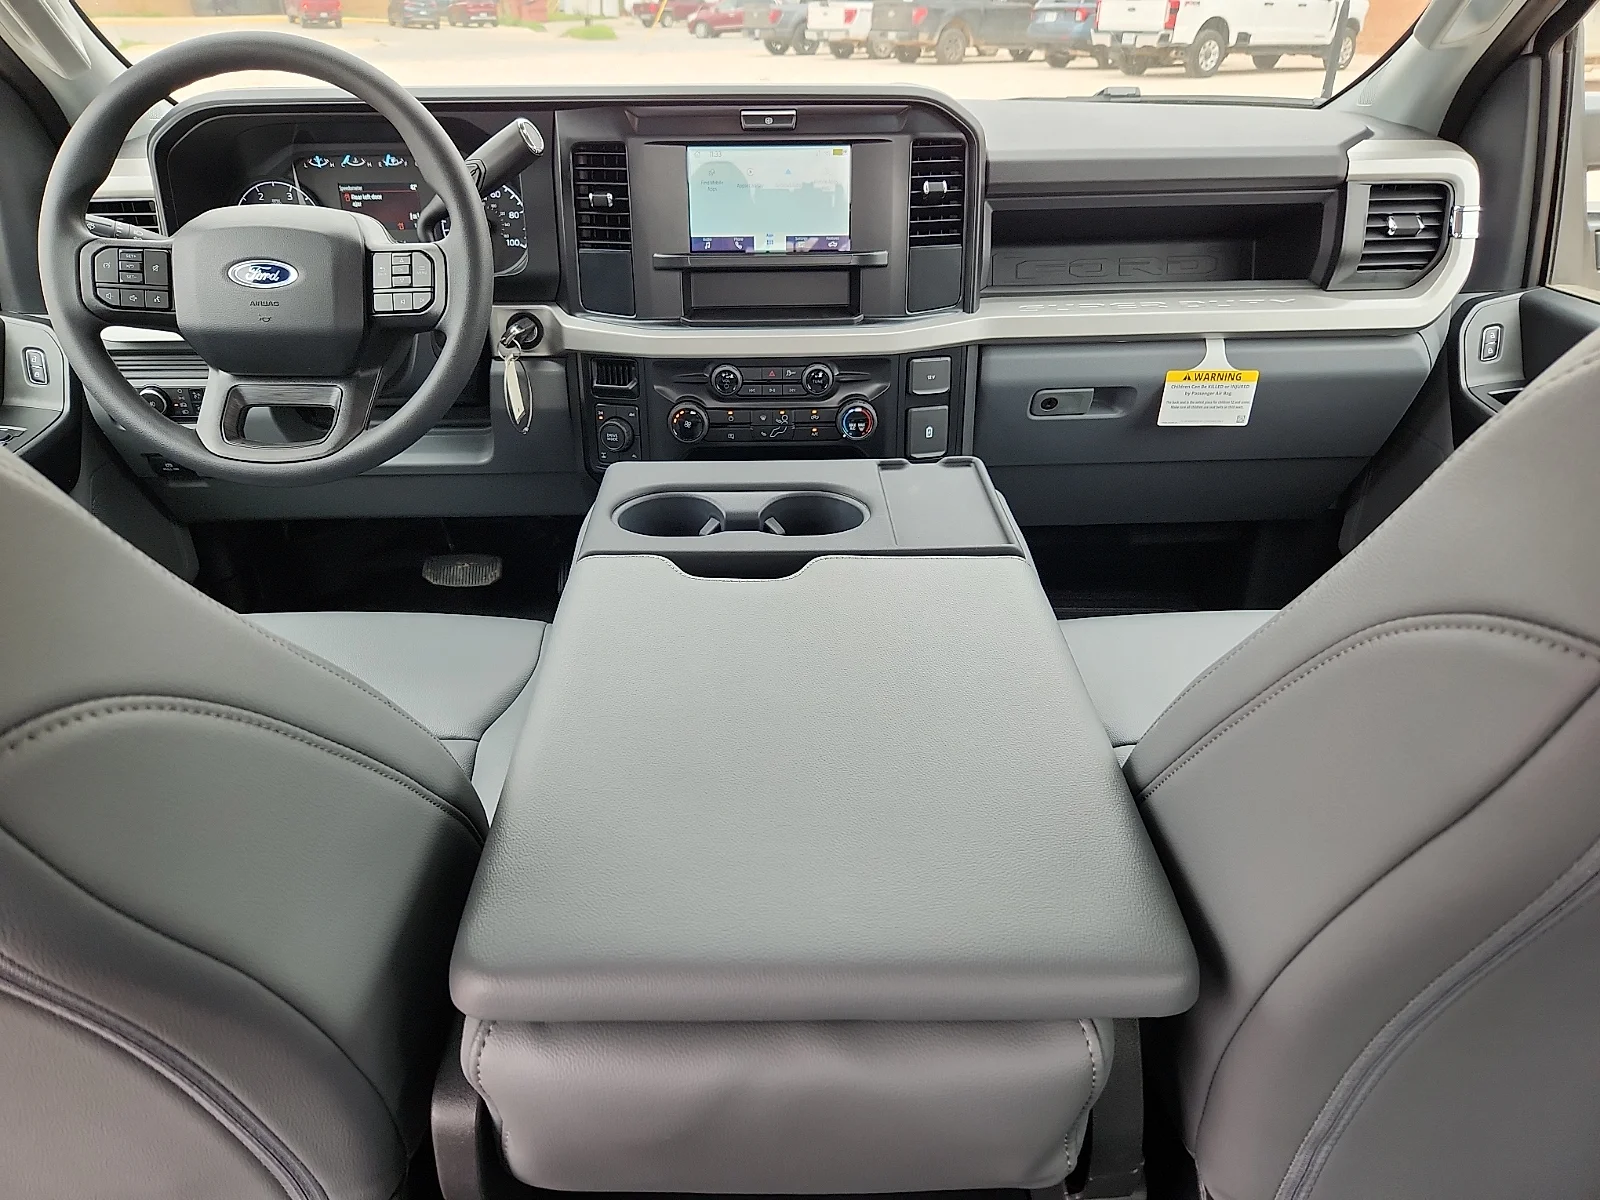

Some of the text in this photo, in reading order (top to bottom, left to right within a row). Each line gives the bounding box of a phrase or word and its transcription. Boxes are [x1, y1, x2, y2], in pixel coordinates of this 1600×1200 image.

[257, 192, 265, 201] 2
[286, 192, 293, 201] 3
[508, 211, 520, 219] 80
[506, 239, 520, 247] 100
[1015, 254, 1219, 281] FORD
[245, 265, 281, 282] Ford
[1178, 298, 1297, 308] DUTY
[1194, 372, 1242, 381] WARNING
